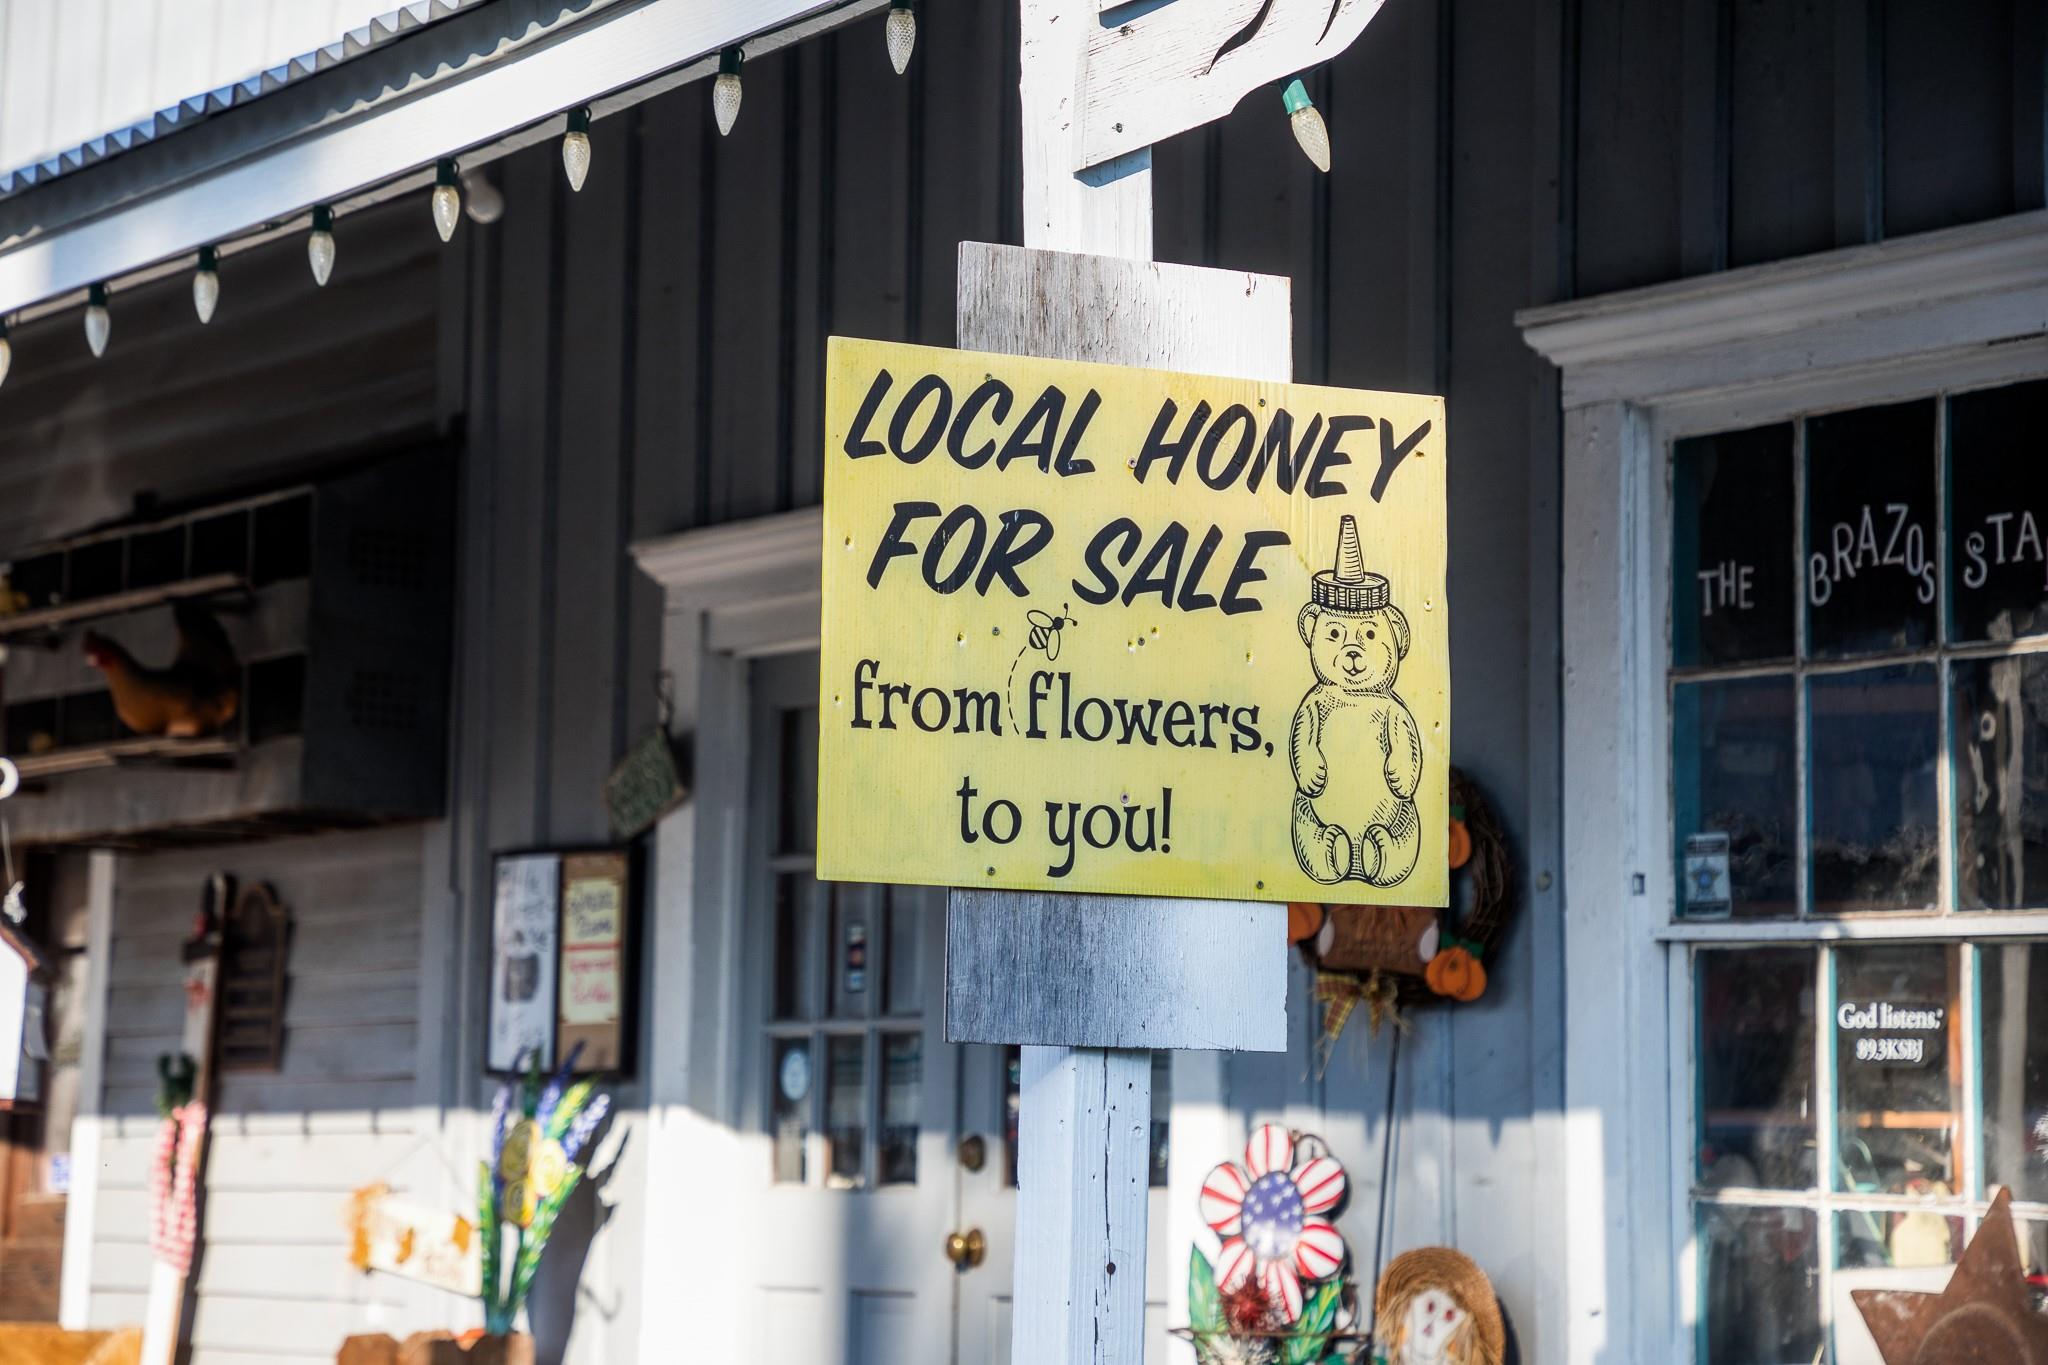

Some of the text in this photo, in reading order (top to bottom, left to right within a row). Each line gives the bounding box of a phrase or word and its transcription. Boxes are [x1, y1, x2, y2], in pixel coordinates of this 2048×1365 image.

[843, 368, 1432, 503] LOCAL HONEY
[866, 501, 1292, 616] FOR SALE
[1697, 503, 2048, 616] THE BRAZOS STA
[849, 659, 1275, 758] from flowers,
[956, 776, 1172, 878] to you!
[1837, 1002, 1878, 1029] God
